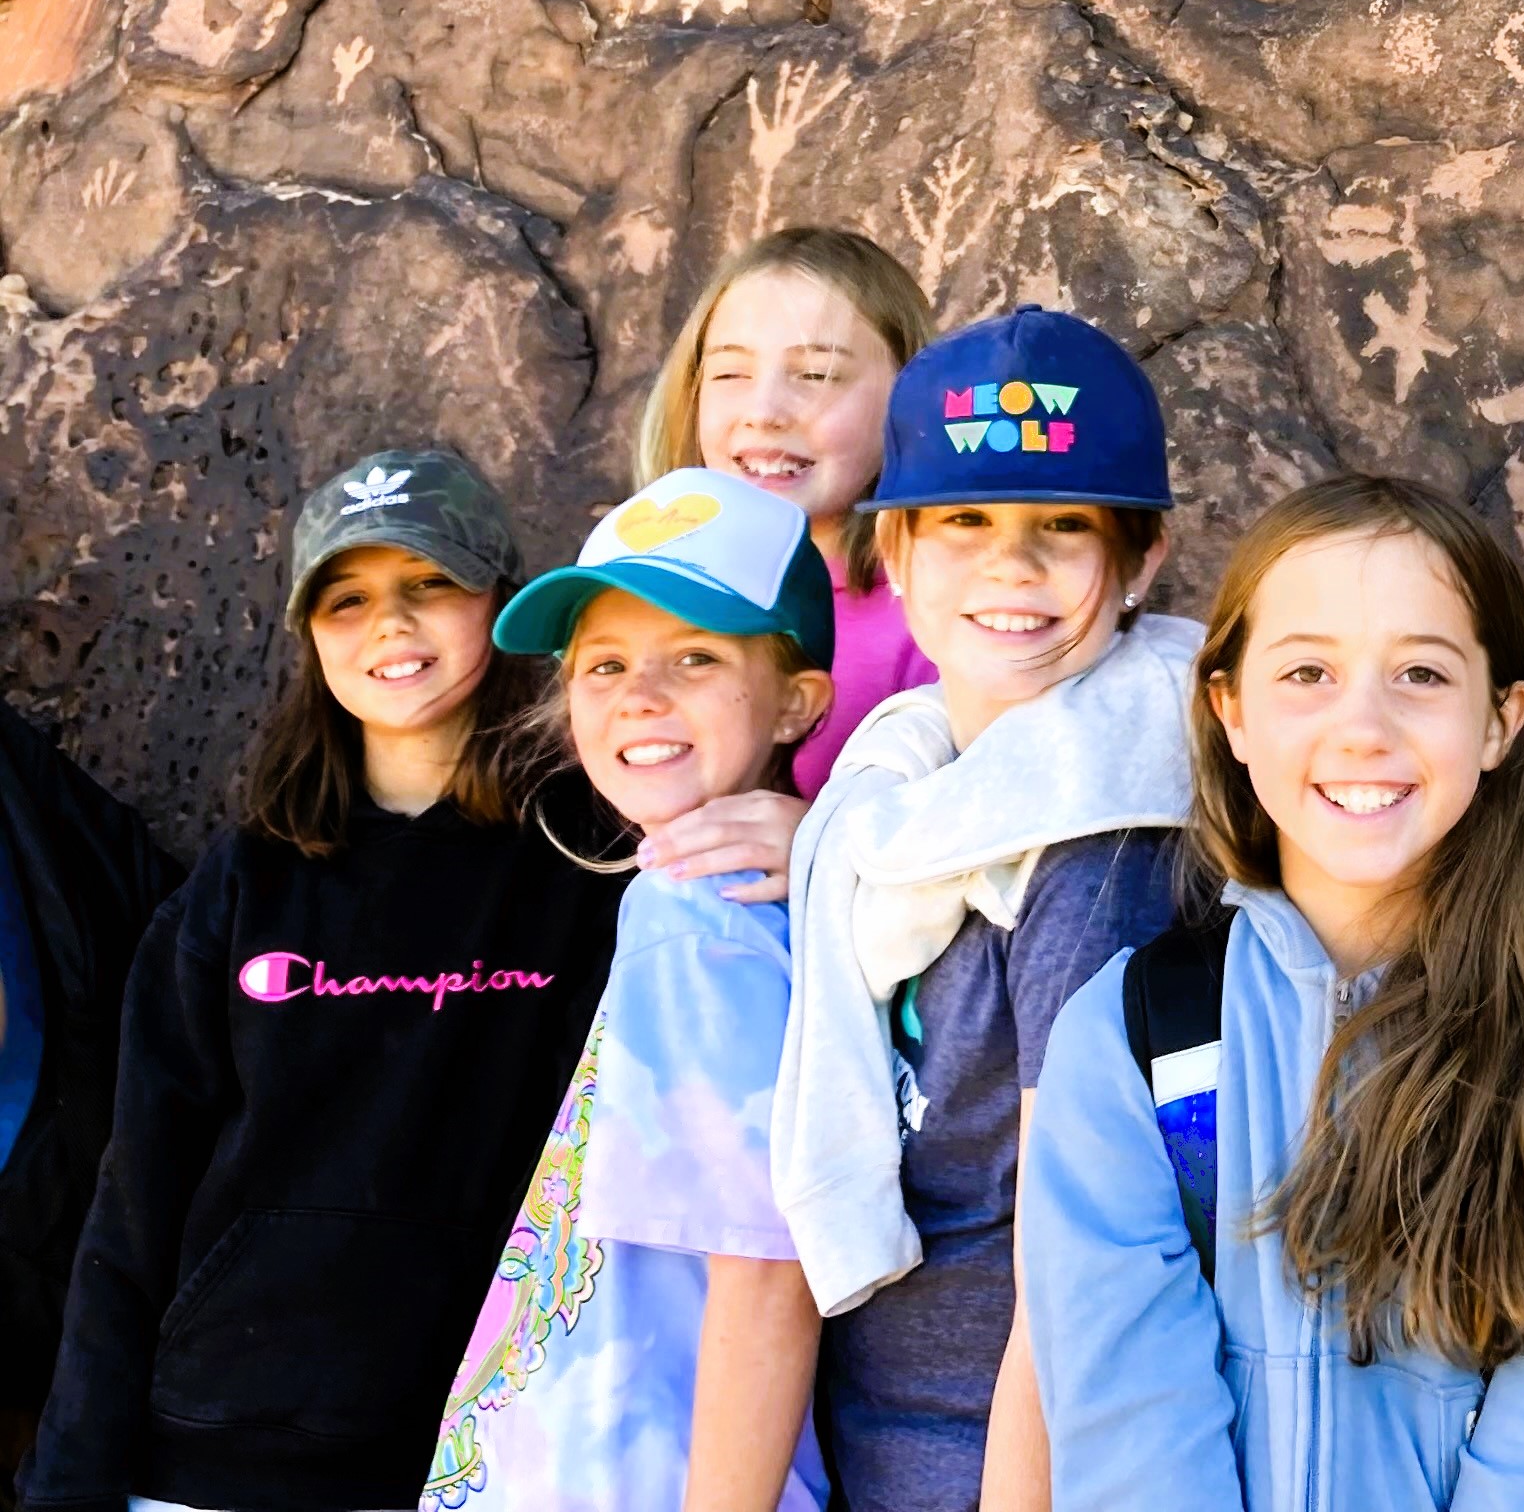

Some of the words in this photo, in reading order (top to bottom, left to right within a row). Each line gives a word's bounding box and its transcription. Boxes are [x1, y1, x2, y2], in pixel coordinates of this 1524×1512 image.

[944, 381, 1079, 418] MEOW
[944, 419, 1075, 454] WOLF
[340, 493, 410, 516] adidas
[239, 951, 555, 1011] Champion
